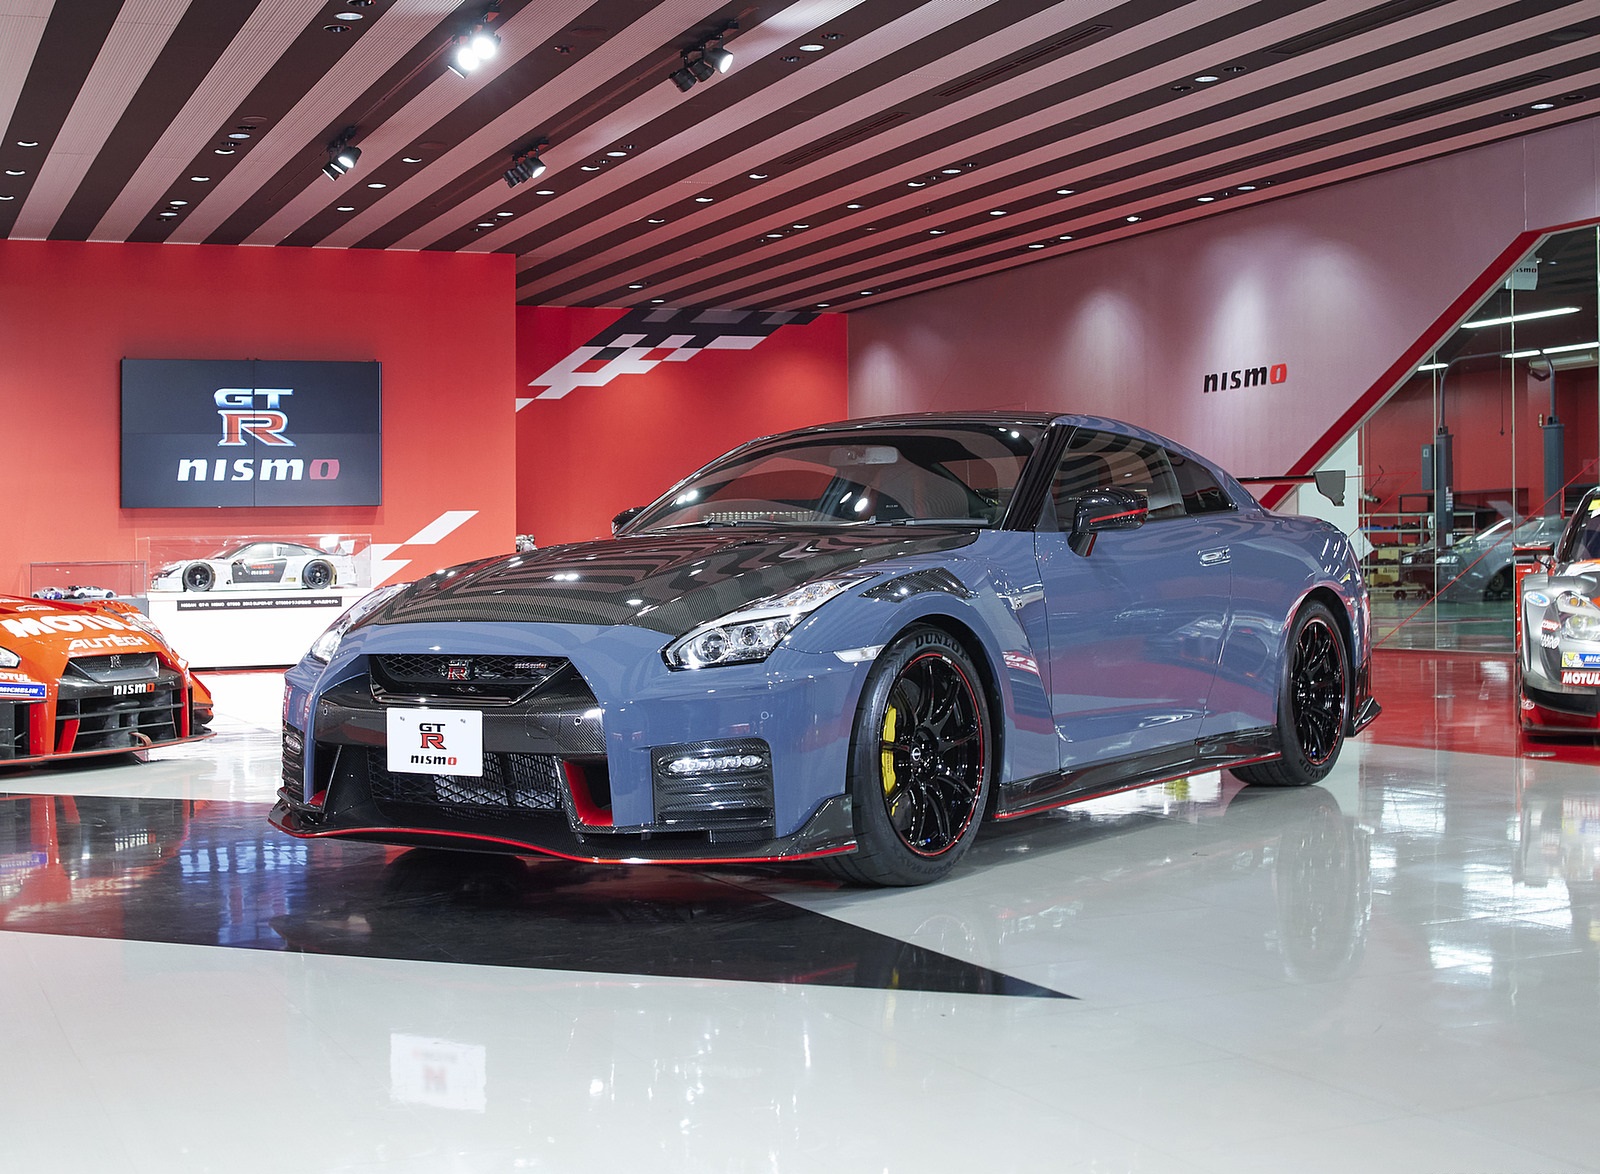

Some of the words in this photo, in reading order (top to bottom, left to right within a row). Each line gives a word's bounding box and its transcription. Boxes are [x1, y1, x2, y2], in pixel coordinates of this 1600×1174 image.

[1203, 363, 1287, 393] nismo
[213, 388, 294, 409] GT
[217, 409, 296, 447] R
[177, 459, 340, 481] nismo
[1562, 672, 1600, 685] MOTUL
[113, 682, 155, 696] nismo
[419, 723, 446, 732] GT
[420, 732, 447, 750] R
[410, 755, 457, 765] nismo
